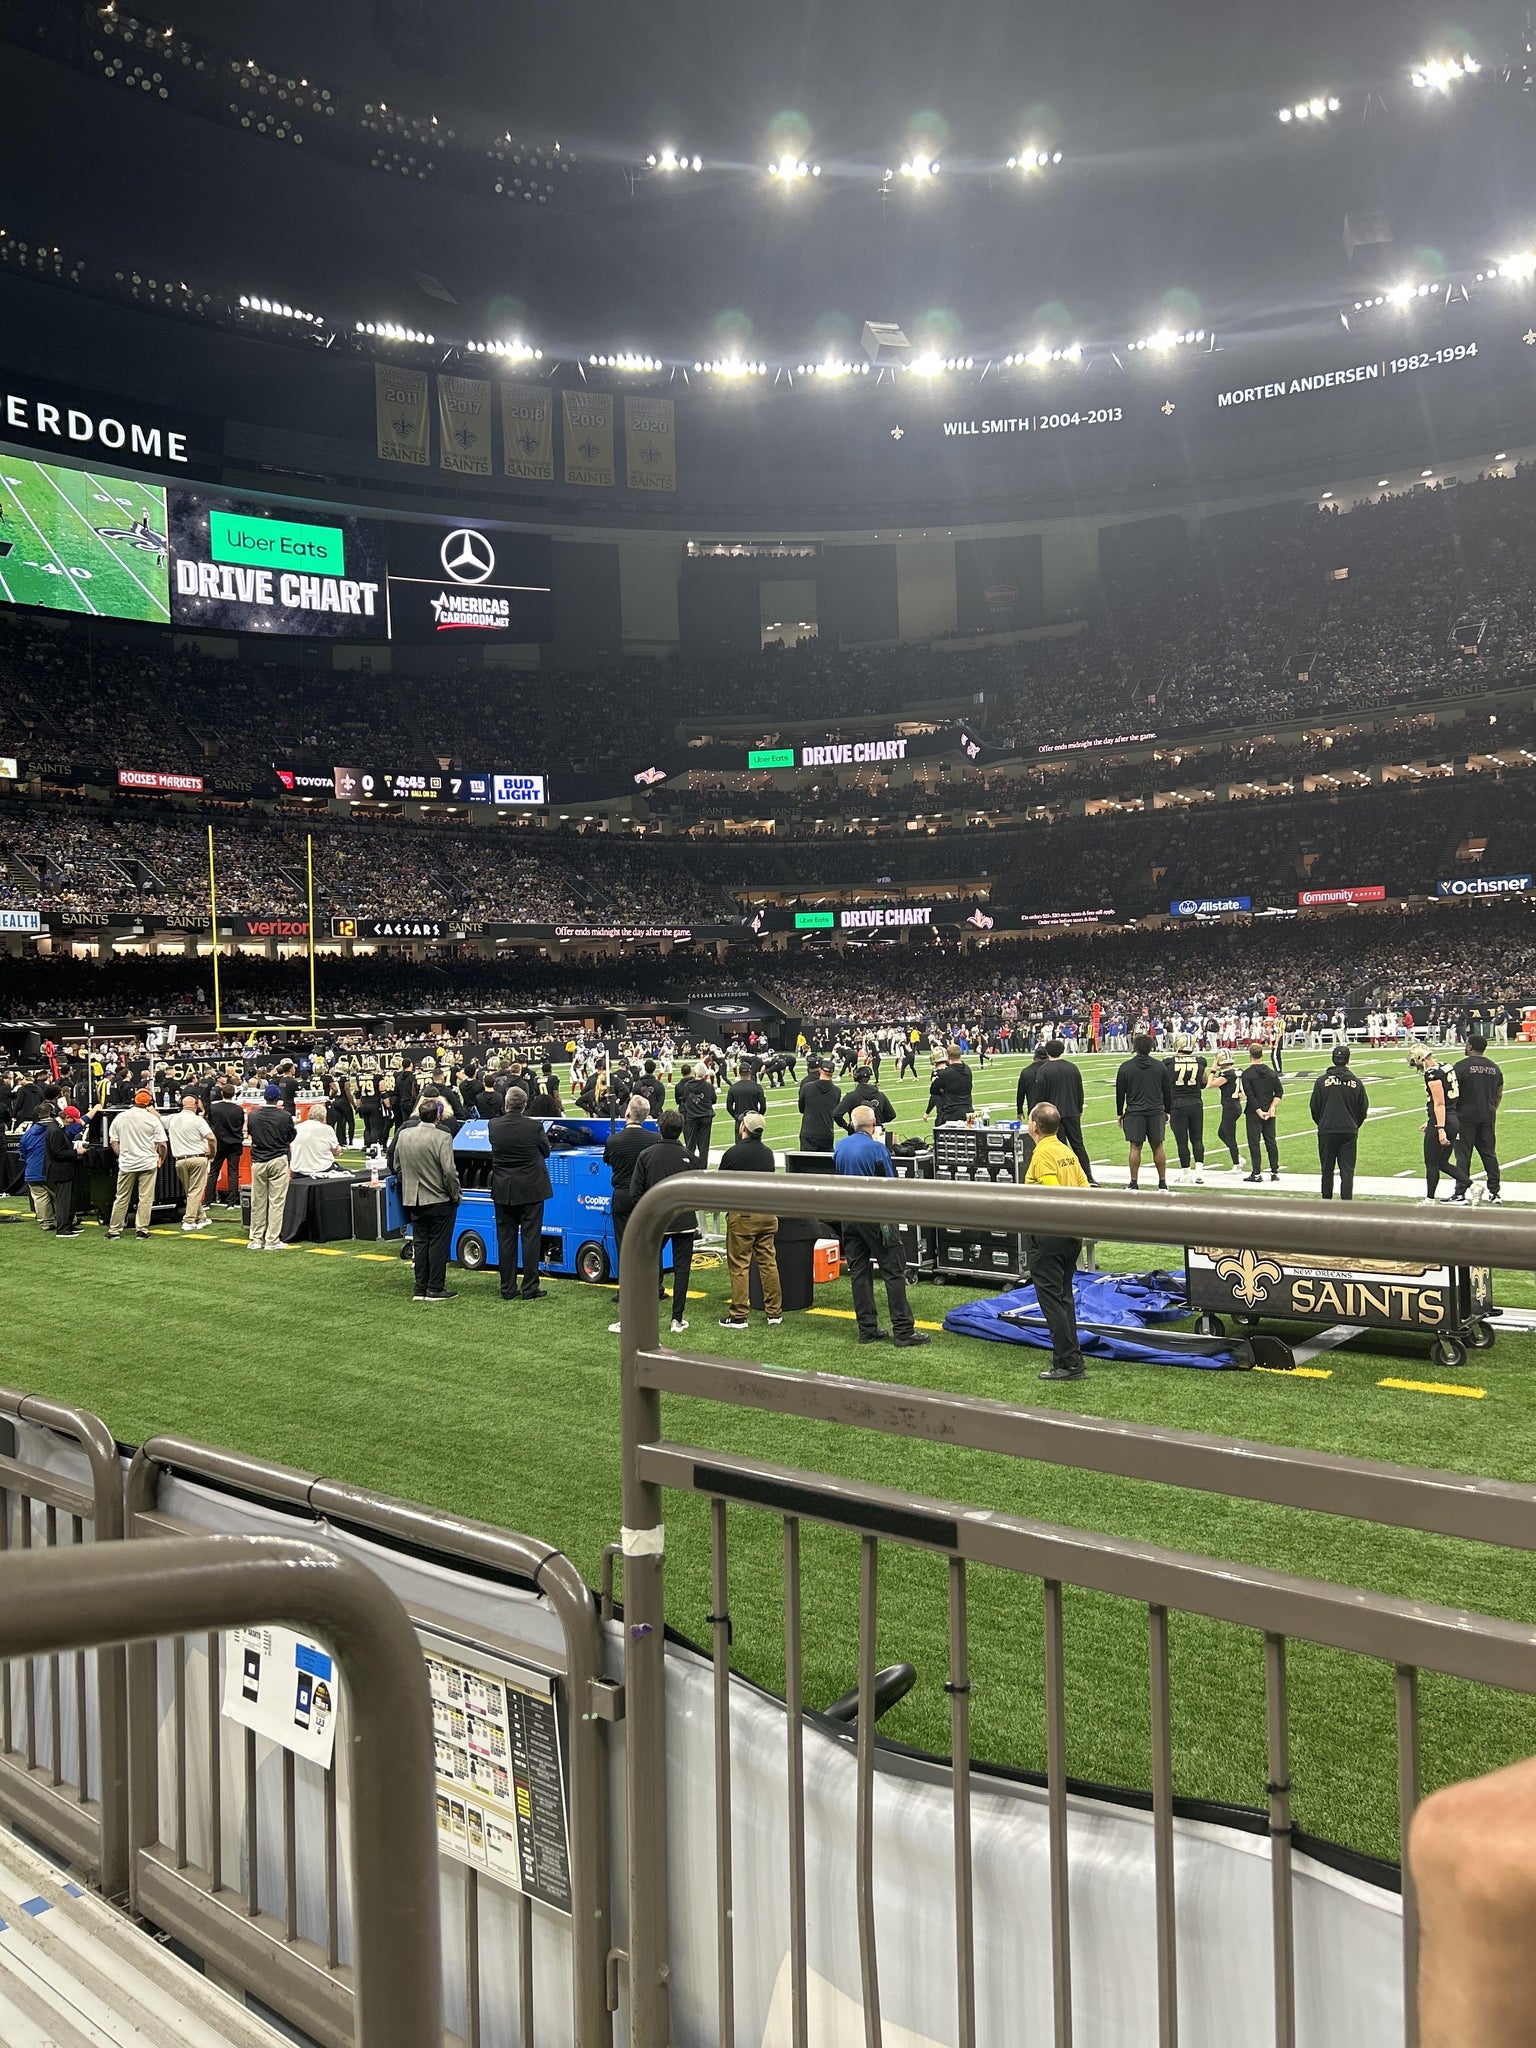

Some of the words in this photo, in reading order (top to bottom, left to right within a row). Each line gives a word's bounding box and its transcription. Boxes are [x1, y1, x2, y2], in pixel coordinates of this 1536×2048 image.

[1217, 381, 1287, 408] MORTEN
[1288, 364, 1379, 395] ANDERSEN
[1389, 342, 1479, 375] 1982-1994
[386, 388, 419, 406] 2011
[448, 399, 481, 416] 2017
[511, 407, 545, 421] 2018
[572, 414, 605, 428] 2019
[632, 418, 668, 433] 2020
[943, 421, 980, 436] WILL
[981, 417, 1030, 434] SMITH
[1039, 407, 1123, 429] 2004-2013
[6, 394, 188, 463] ERDOME
[381, 446, 426, 464] SAINTS
[443, 456, 489, 473] SAINTS
[507, 463, 551, 478] SAINTS
[568, 471, 612, 485] SAINTS
[630, 475, 673, 490] SAINTS
[227, 528, 275, 552] Uber
[280, 537, 328, 558] Eats
[176, 559, 274, 605] DRIVE
[279, 573, 379, 616] CHART
[436, 591, 509, 616] AMERICAS
[440, 610, 510, 628] CARDROOM.NET
[1442, 681, 1489, 697] SAINTS
[1347, 697, 1390, 711] SAINTS
[1255, 710, 1296, 723] SAINTS
[1038, 745, 1054, 753] Offer
[1054, 743, 1068, 751] ends
[1068, 740, 1093, 750] midnight
[1103, 737, 1114, 745] day
[1114, 735, 1129, 744] after
[1140, 732, 1158, 741] game.
[1461, 737, 1502, 751] SAINTS
[771, 754, 789, 762] Eats
[802, 744, 853, 766] DRIVE
[853, 738, 908, 762] CHART
[1373, 749, 1413, 762] SAINTS
[28, 762, 72, 776] SAINTS
[1288, 760, 1326, 772] SAINTS
[120, 771, 157, 786] ROUSES
[159, 775, 202, 790] MARKETS
[1208, 769, 1245, 781] SAINTS
[214, 779, 252, 792] SAINTS
[294, 776, 335, 789] TOYOTA
[361, 774, 375, 791] 0
[396, 775, 426, 789] 4:45
[450, 778, 462, 794] 7
[503, 778, 528, 789] BUD
[1130, 779, 1165, 790] SAINTS
[497, 789, 541, 801] LIGHT
[1057, 788, 1090, 799] SAINTS
[701, 807, 733, 815] SAINTS
[770, 807, 801, 817] SAINTS
[840, 805, 872, 815] SAINTS
[912, 801, 944, 812] SAINTS
[1451, 877, 1529, 895] Ochsner
[1255, 894, 1294, 906] SAINTS
[1302, 889, 1353, 904] Community
[1, 914, 38, 928] EALTH
[61, 913, 109, 925] SAINTS
[166, 915, 210, 928] SAINTS
[814, 916, 829, 924] Eats
[840, 910, 885, 928] DRIVE
[887, 907, 932, 925] CHART
[339, 920, 354, 936] 12
[373, 923, 441, 936] CAESARS
[449, 922, 483, 933] SAINTS
[555, 926, 574, 937] Offer
[574, 928, 591, 937] ends
[591, 927, 620, 938] midnight
[621, 928, 632, 937] the
[632, 928, 645, 938] day
[645, 928, 661, 938] after
[662, 928, 672, 937] the
[673, 929, 692, 938] game.
[485, 1045, 543, 1061] SANTS
[173, 1060, 245, 1081] SAINTS
[1174, 1063, 1199, 1086] 77
[1469, 1065, 1497, 1076] SAINTS
[359, 1080, 376, 1097] 79
[1293, 1268, 1313, 1276] NEW
[1315, 1269, 1353, 1279] ORLEANS
[1291, 1279, 1446, 1324] SAINTS
